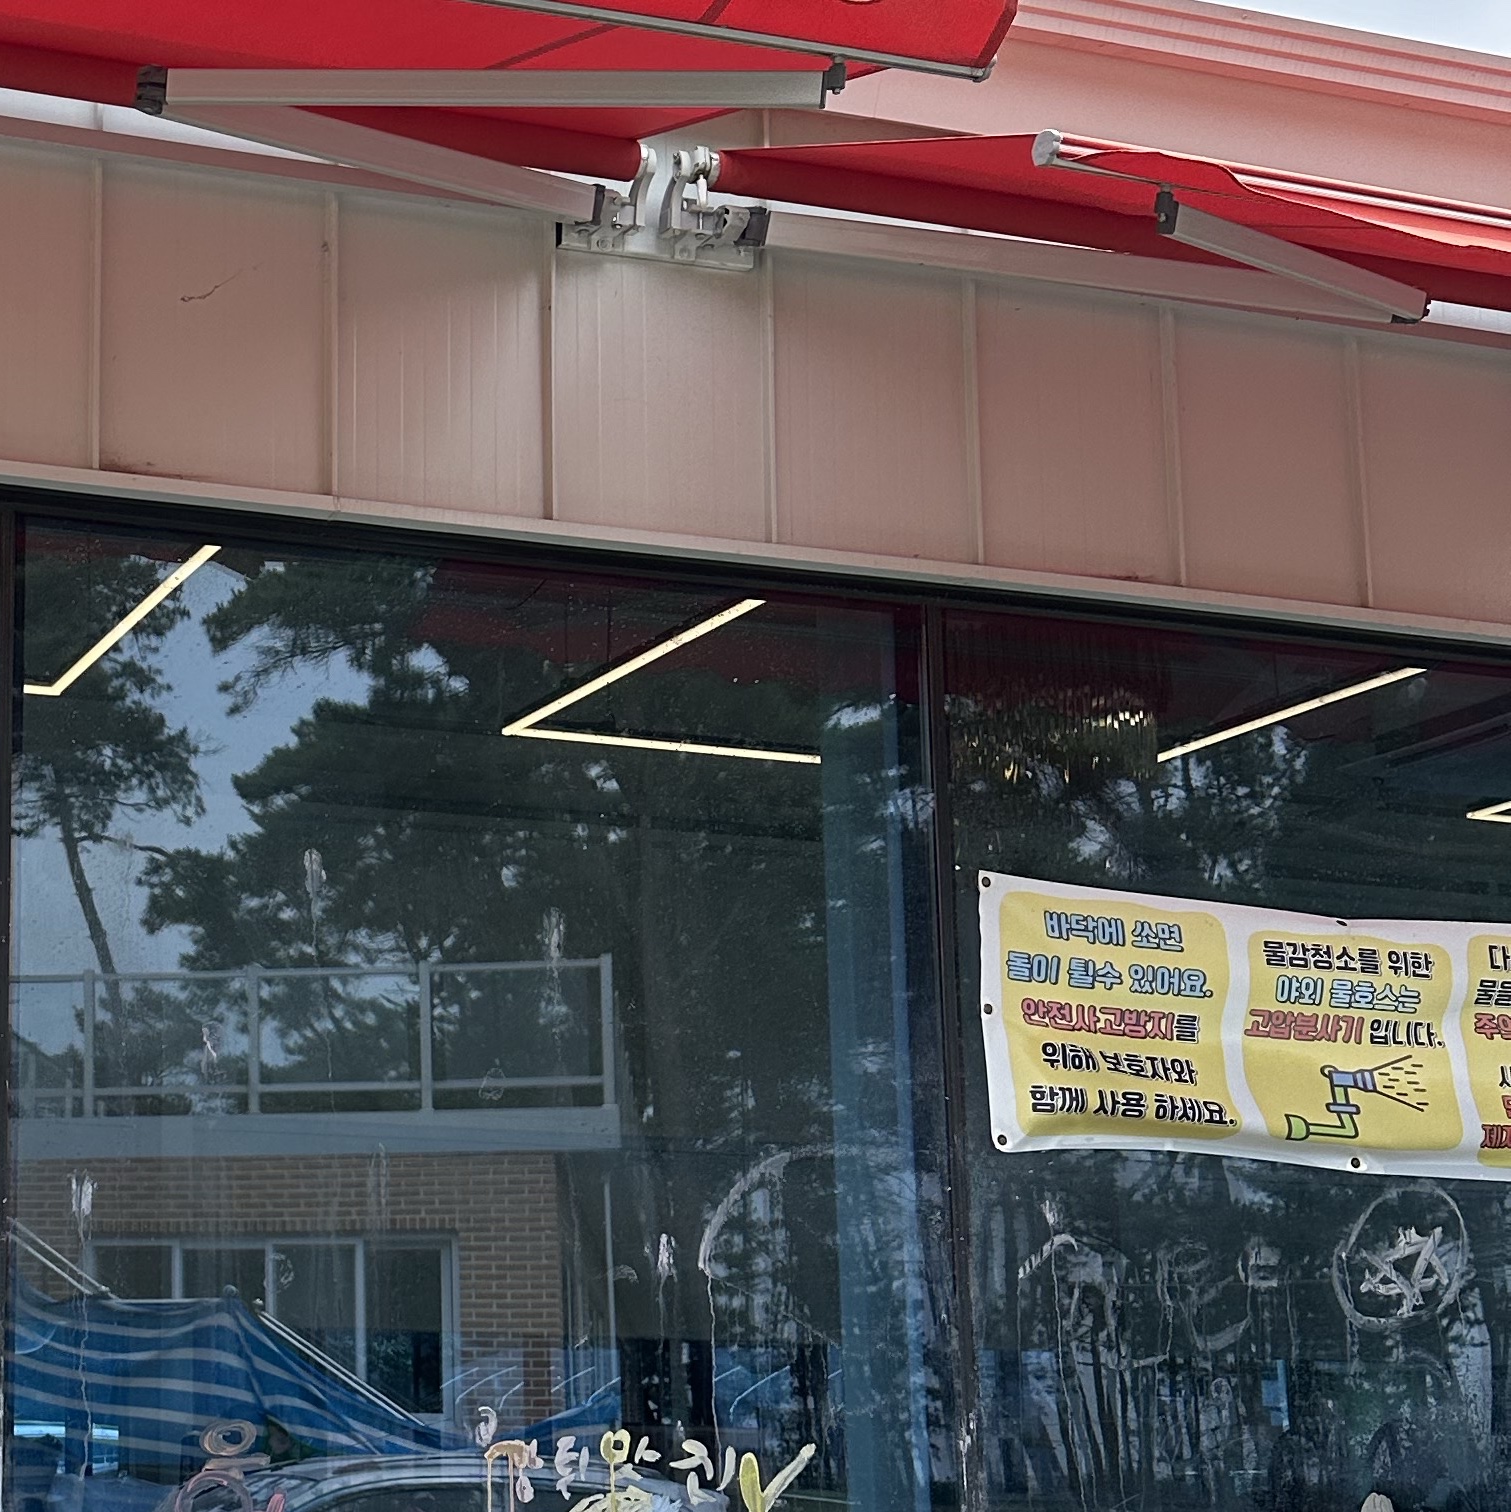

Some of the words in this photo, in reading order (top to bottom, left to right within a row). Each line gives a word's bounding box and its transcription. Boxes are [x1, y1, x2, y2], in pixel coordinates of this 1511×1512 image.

[1043, 910, 1127, 947] 바닥에
[1131, 920, 1185, 952] 쏘면
[1005, 950, 1061, 986] 돌이
[1127, 963, 1214, 999] 있어요.
[1261, 939, 1382, 977] 물감청소를
[1386, 949, 1435, 980] 위한
[1274, 974, 1325, 1006] 야외
[1328, 978, 1422, 1014] 물호스는
[1020, 997, 1200, 1044] 안전사고방지를
[1243, 1008, 1365, 1045] 고압분사기
[1368, 1018, 1446, 1049] 입니다.
[1040, 1041, 1099, 1072] 위해
[1099, 1050, 1199, 1086] 보호자와
[1029, 1084, 1089, 1115] 함께
[1092, 1088, 1148, 1119] 사용
[1153, 1092, 1238, 1127] 하세요.
